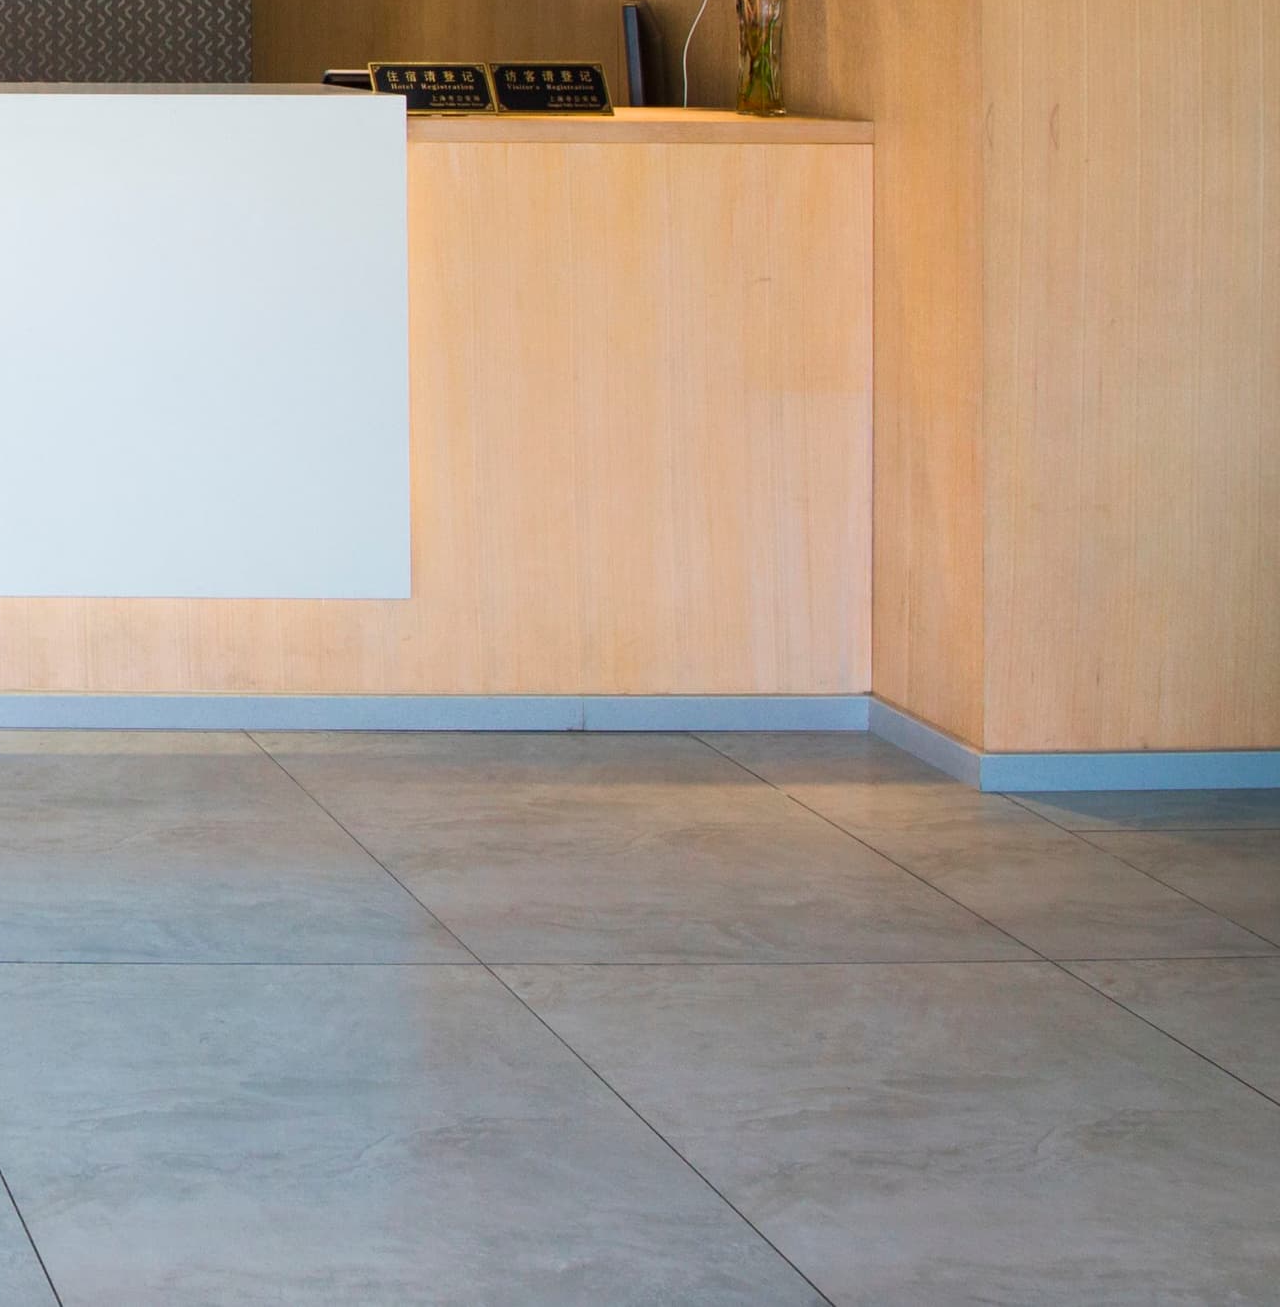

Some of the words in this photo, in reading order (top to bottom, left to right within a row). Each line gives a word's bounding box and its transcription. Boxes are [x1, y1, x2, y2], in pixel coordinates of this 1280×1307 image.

[386, 70, 475, 83] 住宿请登记
[504, 70, 593, 83] 访客请登记
